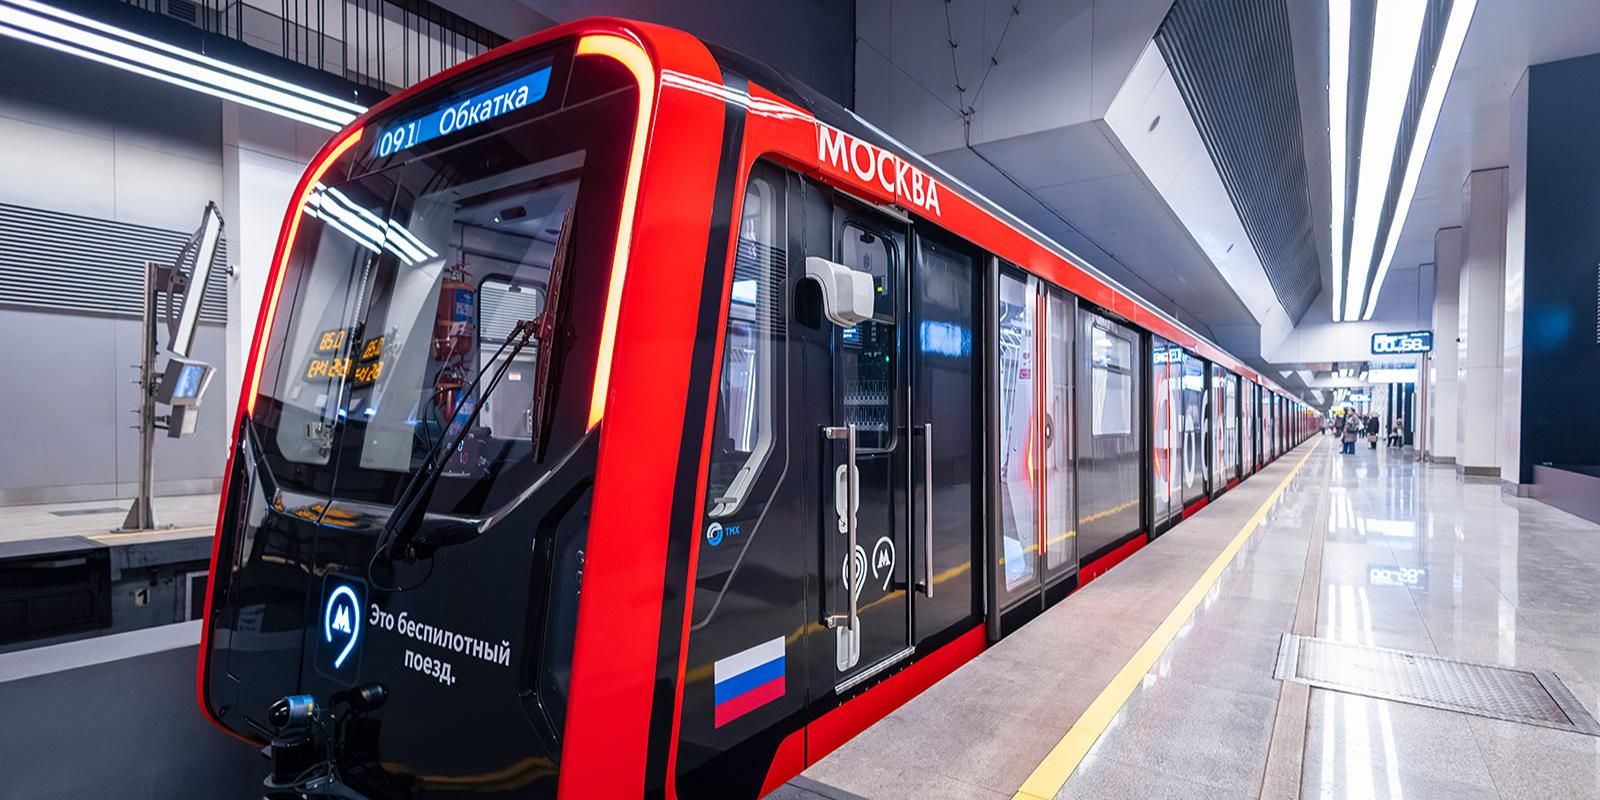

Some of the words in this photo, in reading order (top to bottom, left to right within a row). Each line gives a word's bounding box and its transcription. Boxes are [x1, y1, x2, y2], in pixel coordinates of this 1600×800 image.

[379, 122, 416, 157] 091
[439, 85, 529, 136] Обкатка
[819, 125, 942, 217] МОСКВА
[138, 589, 147, 605] 1
[369, 603, 395, 631] Это
[397, 611, 512, 667] беспилотный
[404, 649, 456, 686] поезд.
